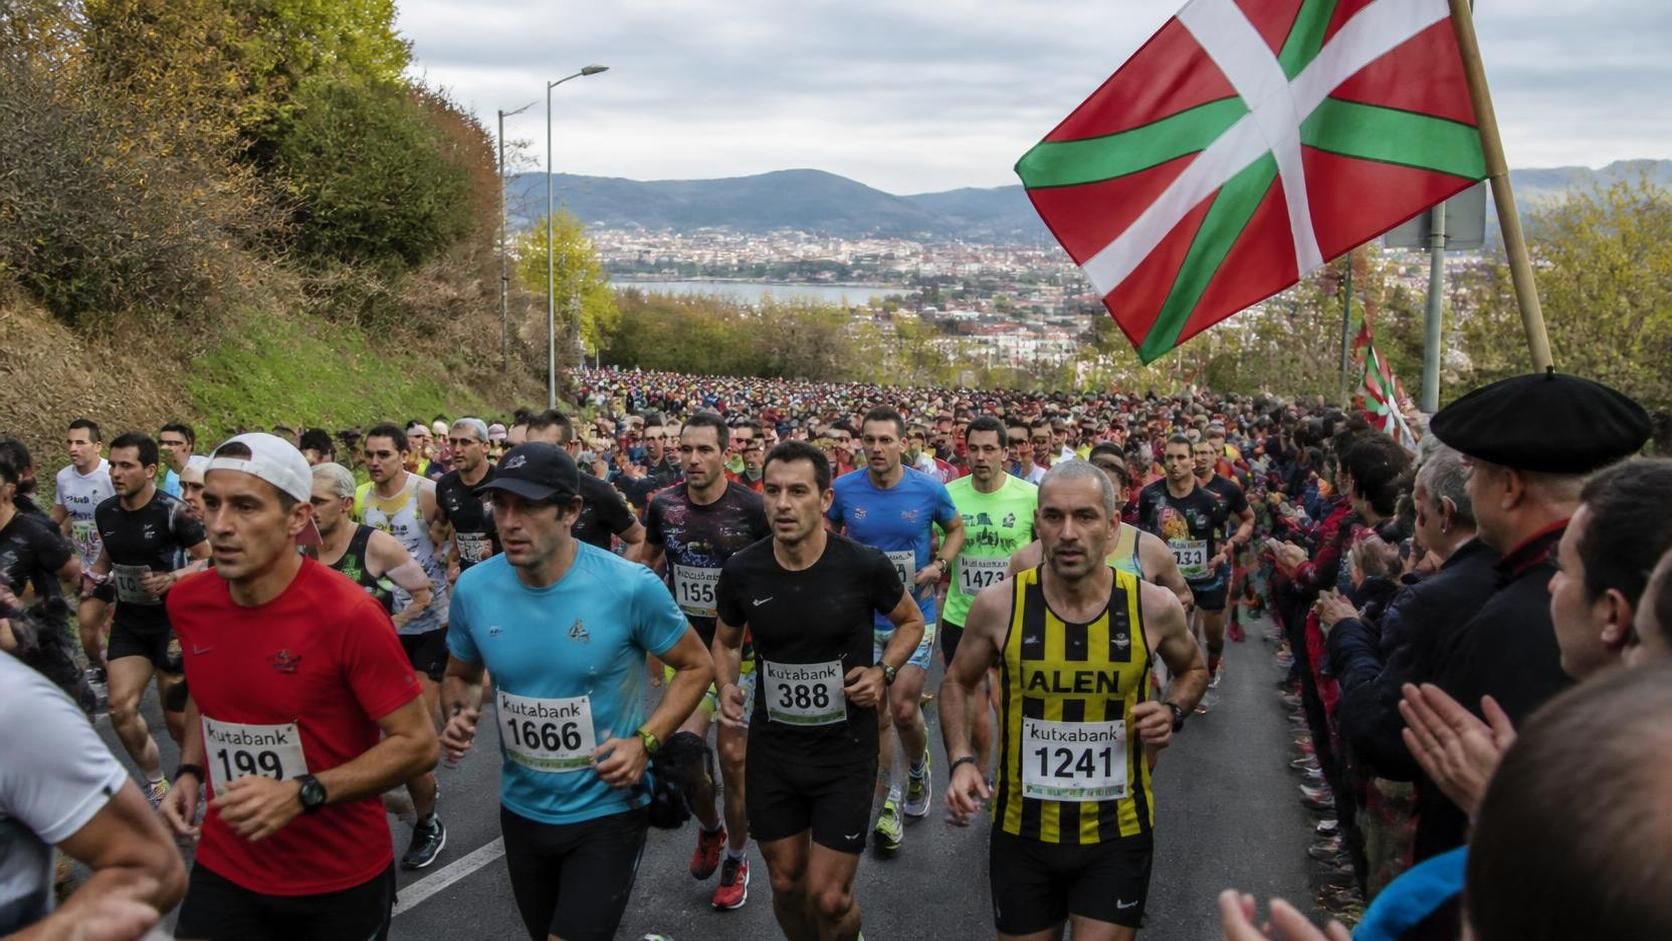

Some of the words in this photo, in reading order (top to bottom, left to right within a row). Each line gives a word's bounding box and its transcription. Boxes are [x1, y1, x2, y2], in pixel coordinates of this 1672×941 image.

[681, 581, 718, 602] 155
[1028, 670, 1120, 693] ALEN
[778, 683, 829, 709] 388
[508, 718, 582, 751] 1666
[1031, 724, 1117, 742] kutxabank
[217, 748, 283, 781] 199
[1035, 747, 1112, 778] 1241
